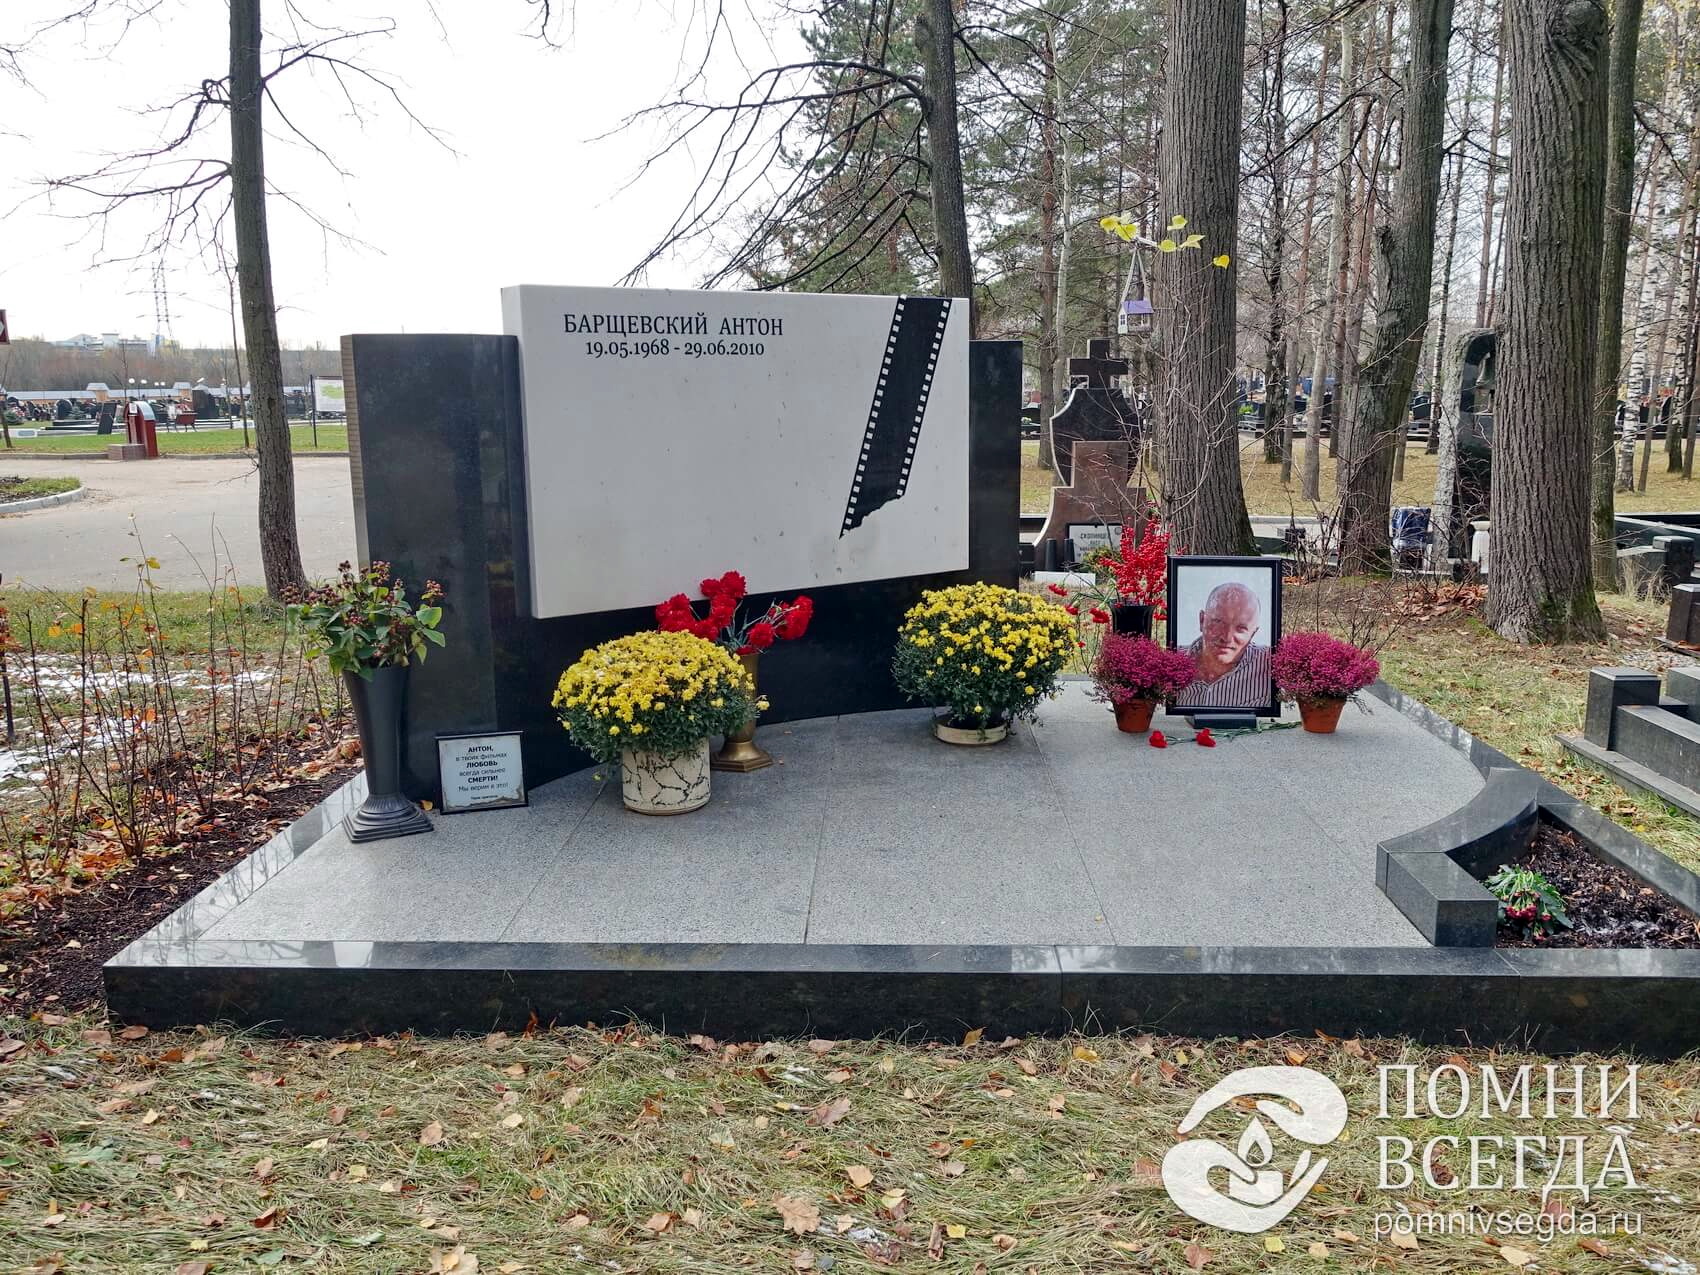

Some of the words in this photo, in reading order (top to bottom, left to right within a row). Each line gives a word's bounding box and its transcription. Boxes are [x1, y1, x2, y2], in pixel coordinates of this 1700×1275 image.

[563, 312, 708, 337] БАРЩЕВСКИЙ
[719, 317, 784, 336] АНТОН
[586, 338, 670, 359] 19.05.1968
[684, 339, 765, 359] 29.06.2010
[468, 745, 494, 753] АНТОН,
[466, 760, 498, 769] ЛЮБОВЬ
[467, 775, 498, 784] СМЕРТИ!
